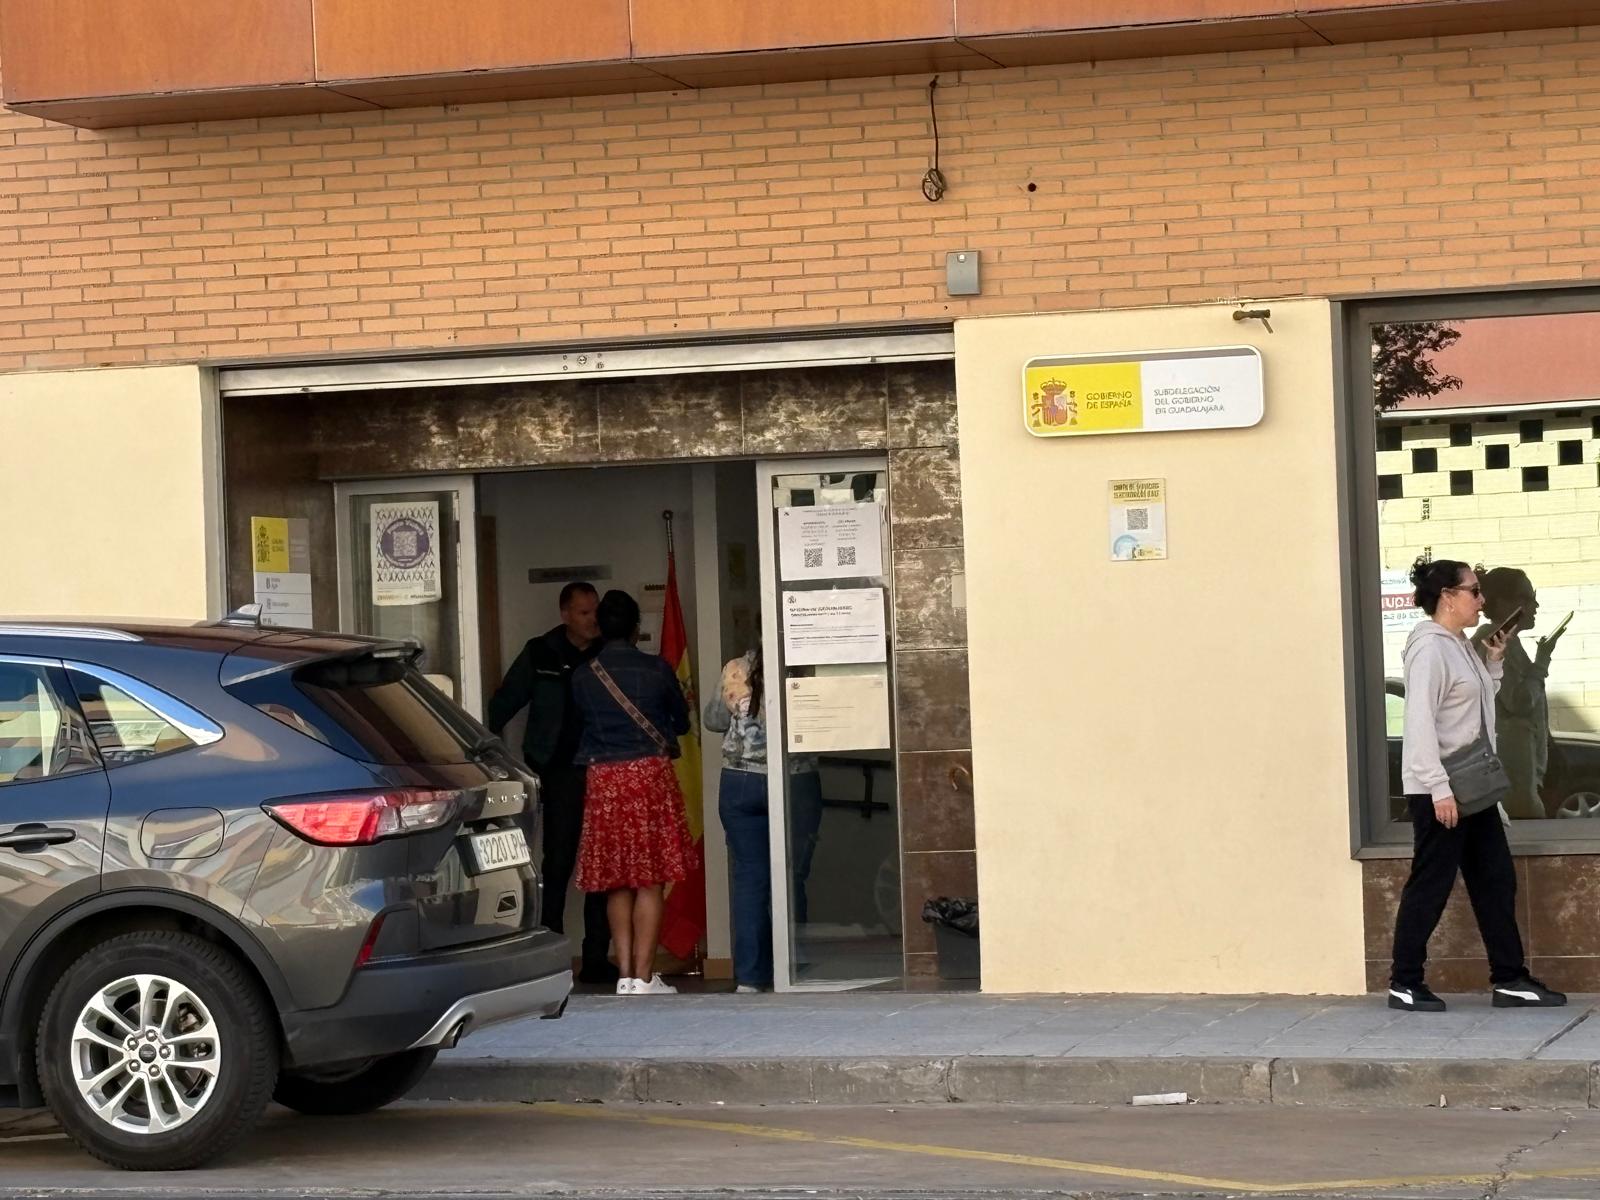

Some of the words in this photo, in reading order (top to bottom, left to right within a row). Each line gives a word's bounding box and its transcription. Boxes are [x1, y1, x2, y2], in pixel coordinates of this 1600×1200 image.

[1086, 391, 1133, 401] GOBIERNO
[1153, 385, 1221, 396] SUBDELEGACIÓN
[1086, 401, 1099, 410] DE
[1100, 399, 1132, 409] ESPAÑA
[1154, 398, 1170, 406] DEL
[1171, 396, 1214, 405] GOBIERNO
[1168, 404, 1225, 415] GUADALAJARA
